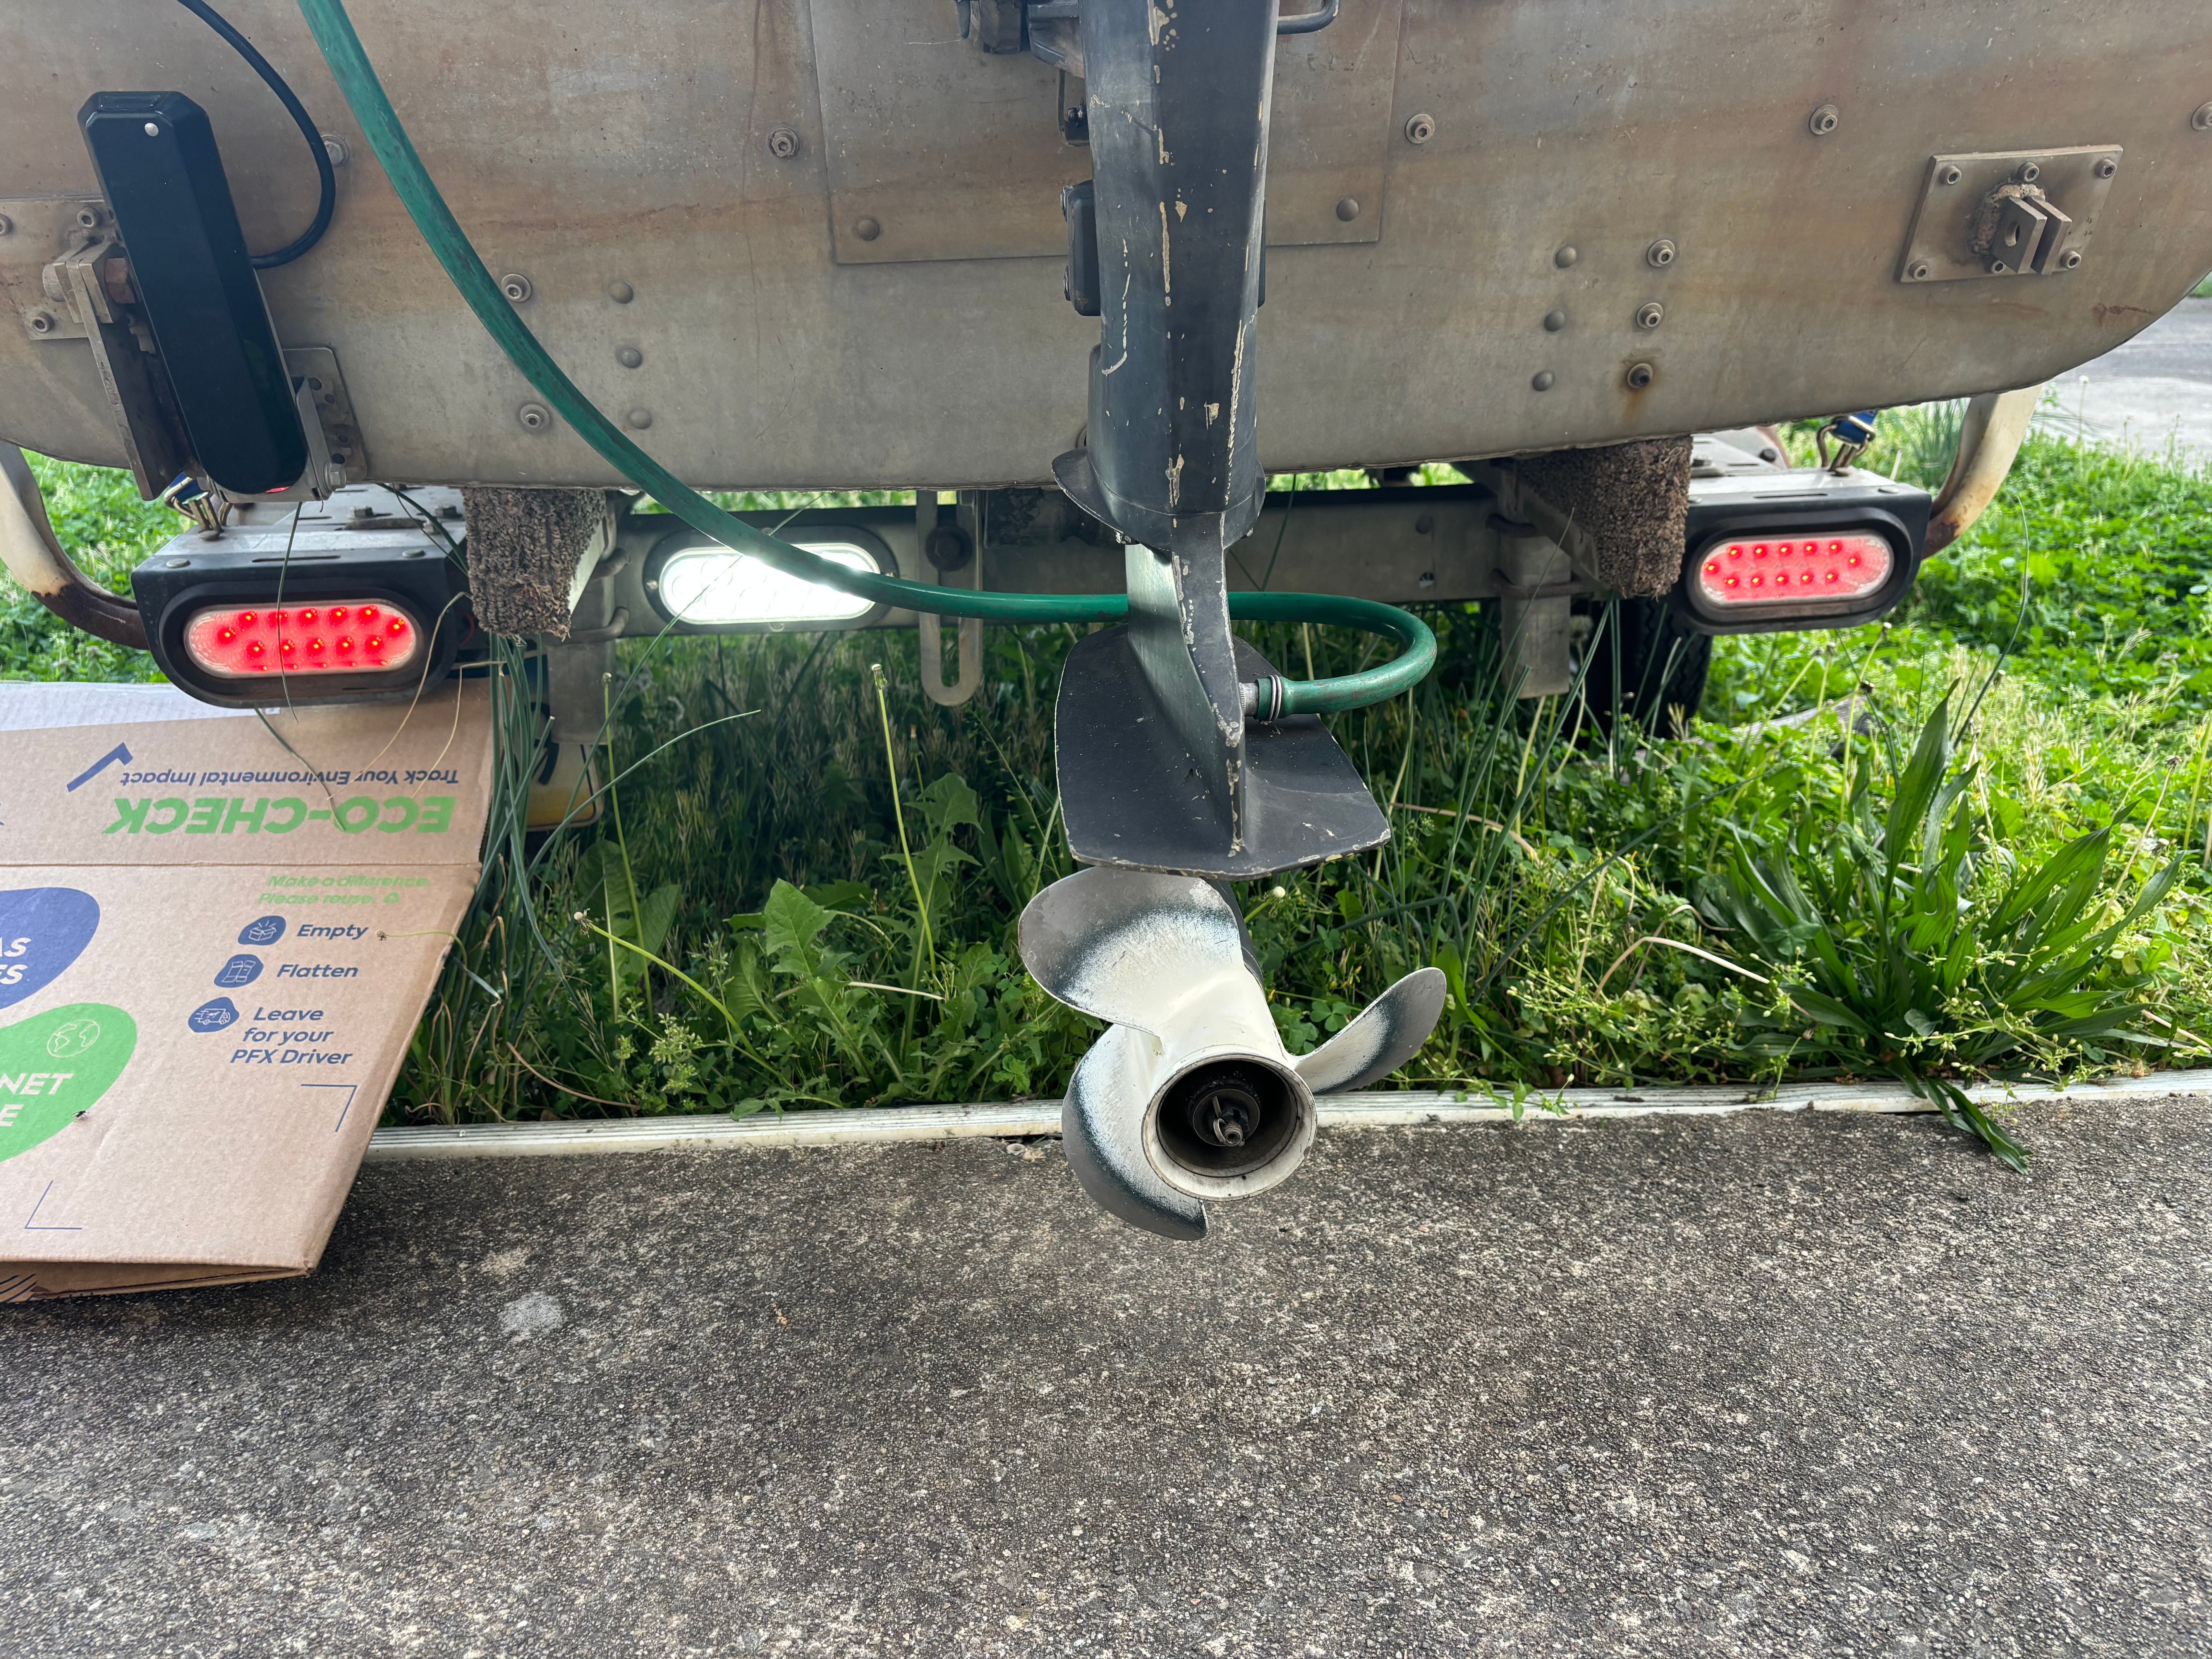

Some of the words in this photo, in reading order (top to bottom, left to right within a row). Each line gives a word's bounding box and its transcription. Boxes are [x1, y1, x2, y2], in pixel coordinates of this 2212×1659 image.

[120, 769, 196, 787] Impact
[199, 771, 351, 786] Environmental
[356, 770, 398, 784] Your
[404, 770, 459, 784] Track
[101, 796, 456, 835] ECO-CHECK
[268, 875, 319, 886] Make
[322, 878, 335, 887] a
[258, 893, 318, 904] Please
[297, 924, 369, 940] Empty
[276, 964, 359, 977] Flatten
[253, 1007, 324, 1021] Leave
[242, 1027, 279, 1042] for
[277, 1031, 334, 1046] your
[230, 1049, 279, 1064] PFX
[280, 1049, 353, 1065] Driver
